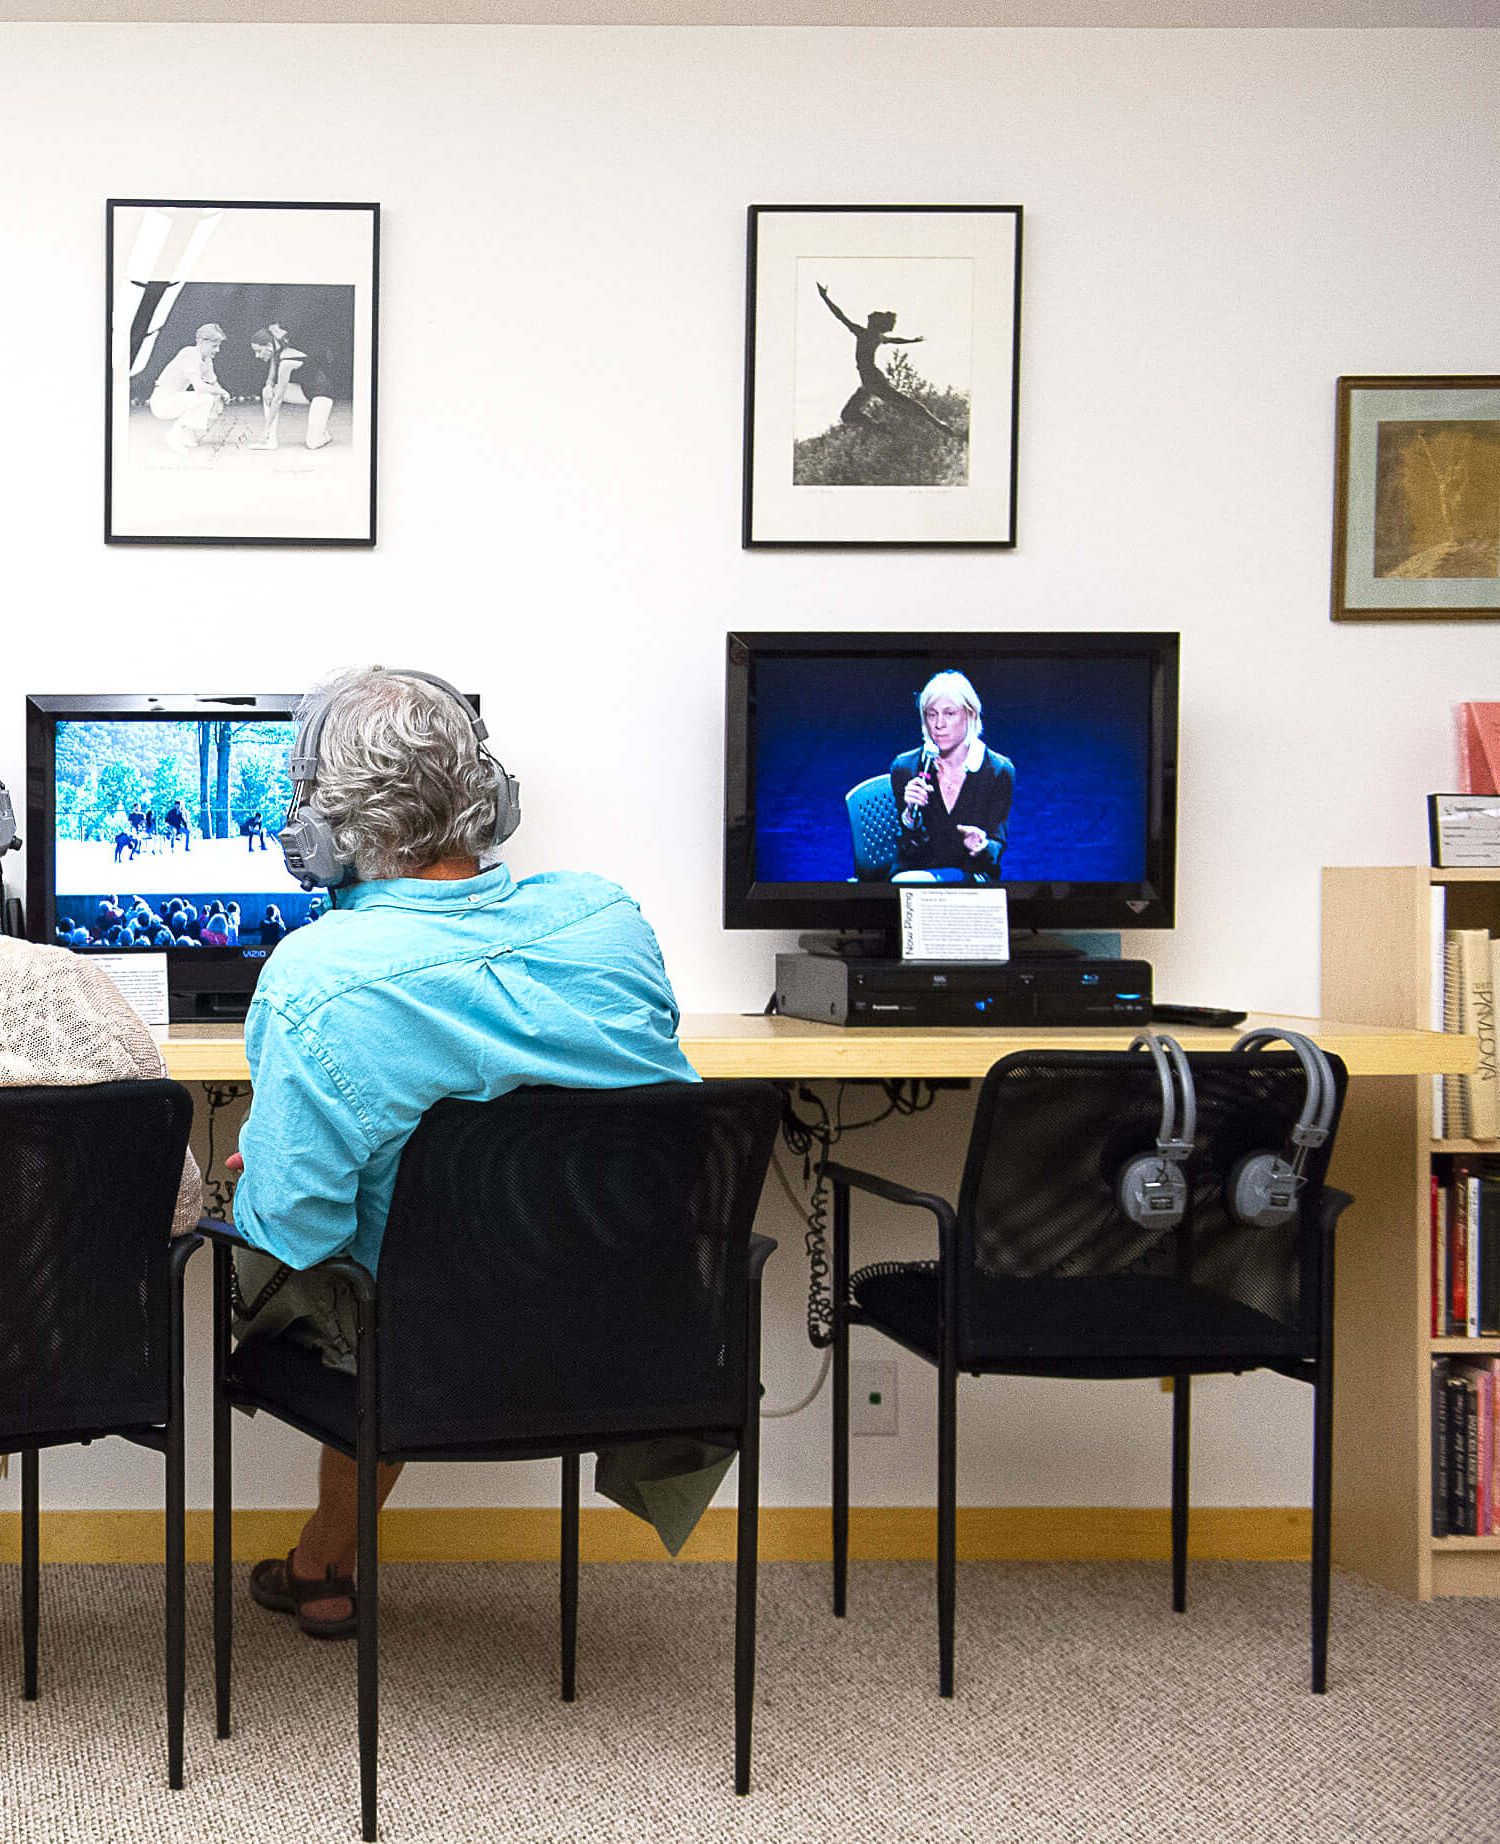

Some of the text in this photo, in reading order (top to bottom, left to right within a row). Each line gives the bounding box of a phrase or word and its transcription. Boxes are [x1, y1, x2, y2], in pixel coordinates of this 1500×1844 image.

[242, 949, 267, 958] VIZIO
[904, 891, 915, 956] Now Playing
[1472, 989, 1497, 1082] PAVLOVA
